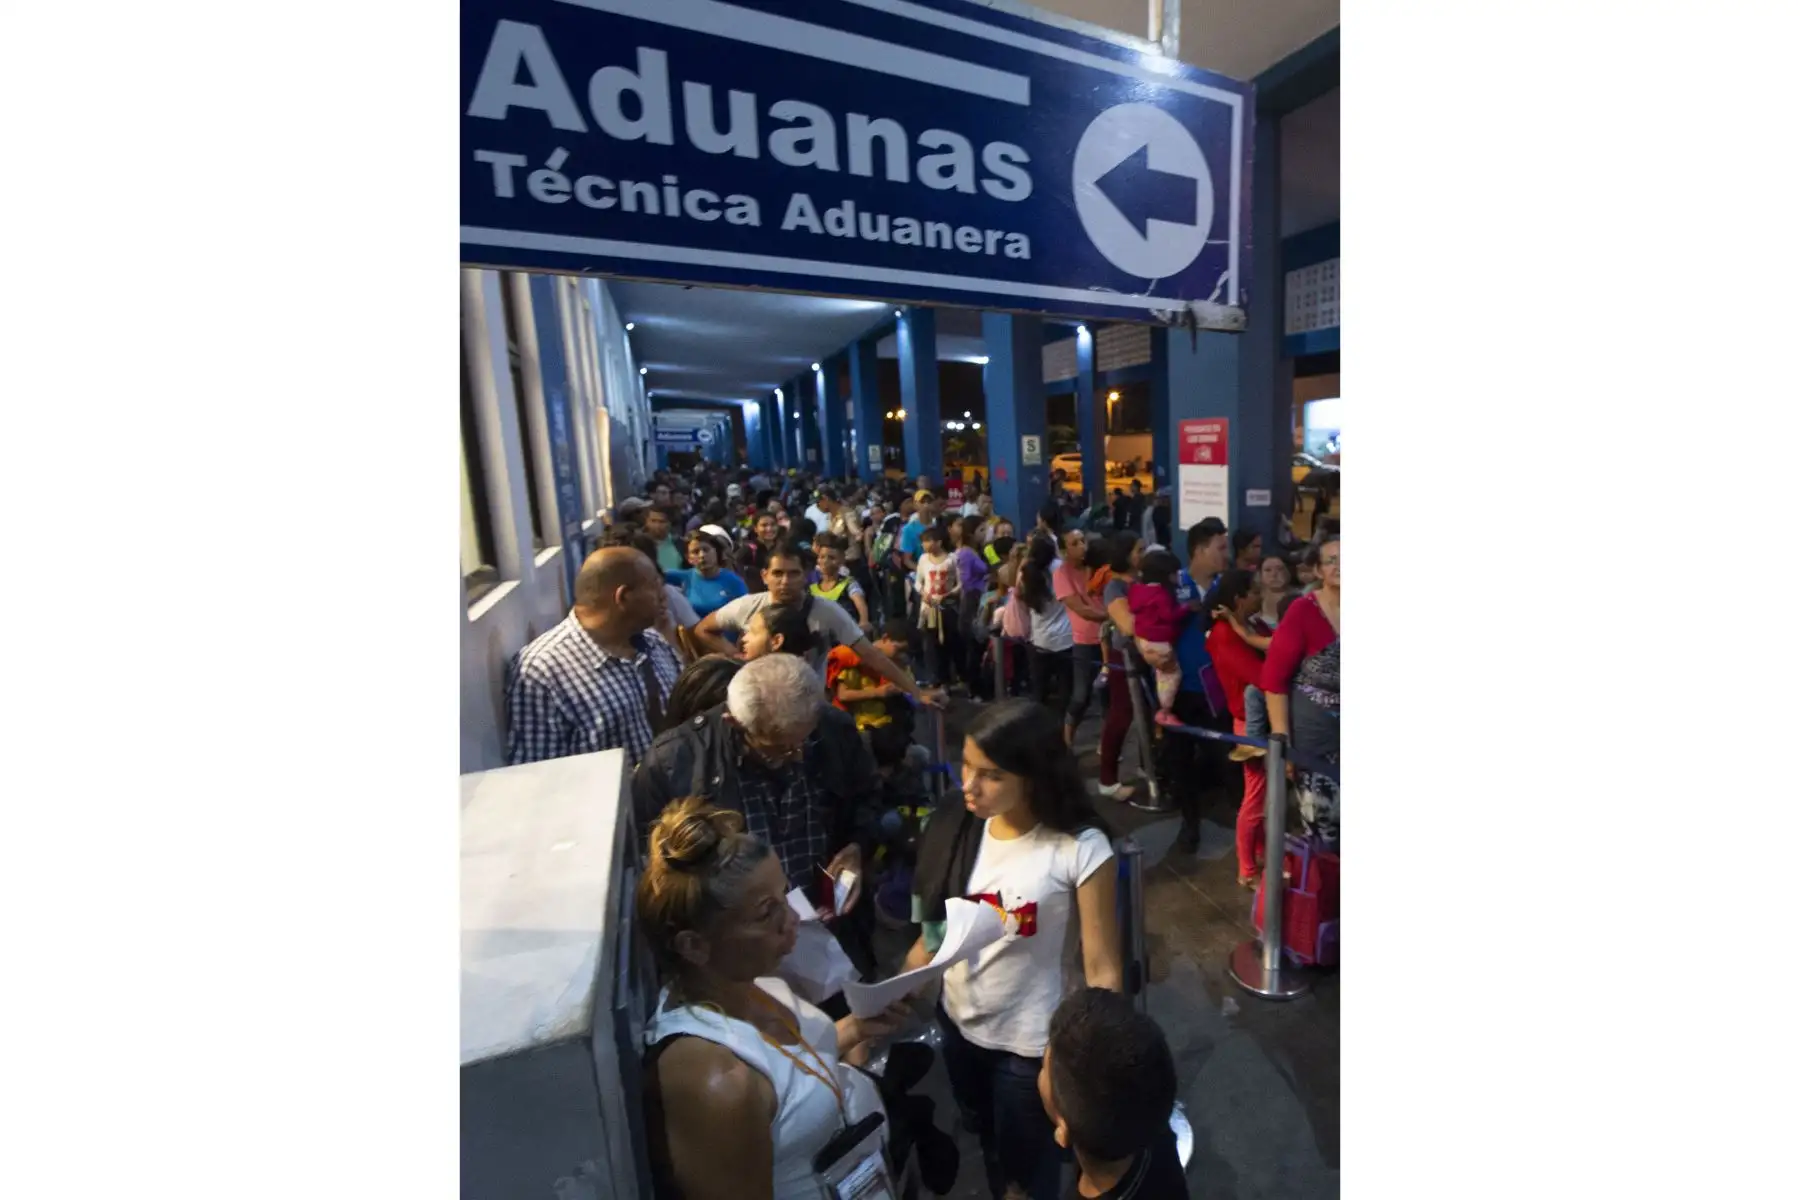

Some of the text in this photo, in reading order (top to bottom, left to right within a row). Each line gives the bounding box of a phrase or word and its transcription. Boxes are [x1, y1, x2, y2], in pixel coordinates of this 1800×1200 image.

[468, 19, 1033, 203] Aduanas
[475, 147, 1032, 261] Técnica Aduanera
[1026, 438, 1037, 453] S
